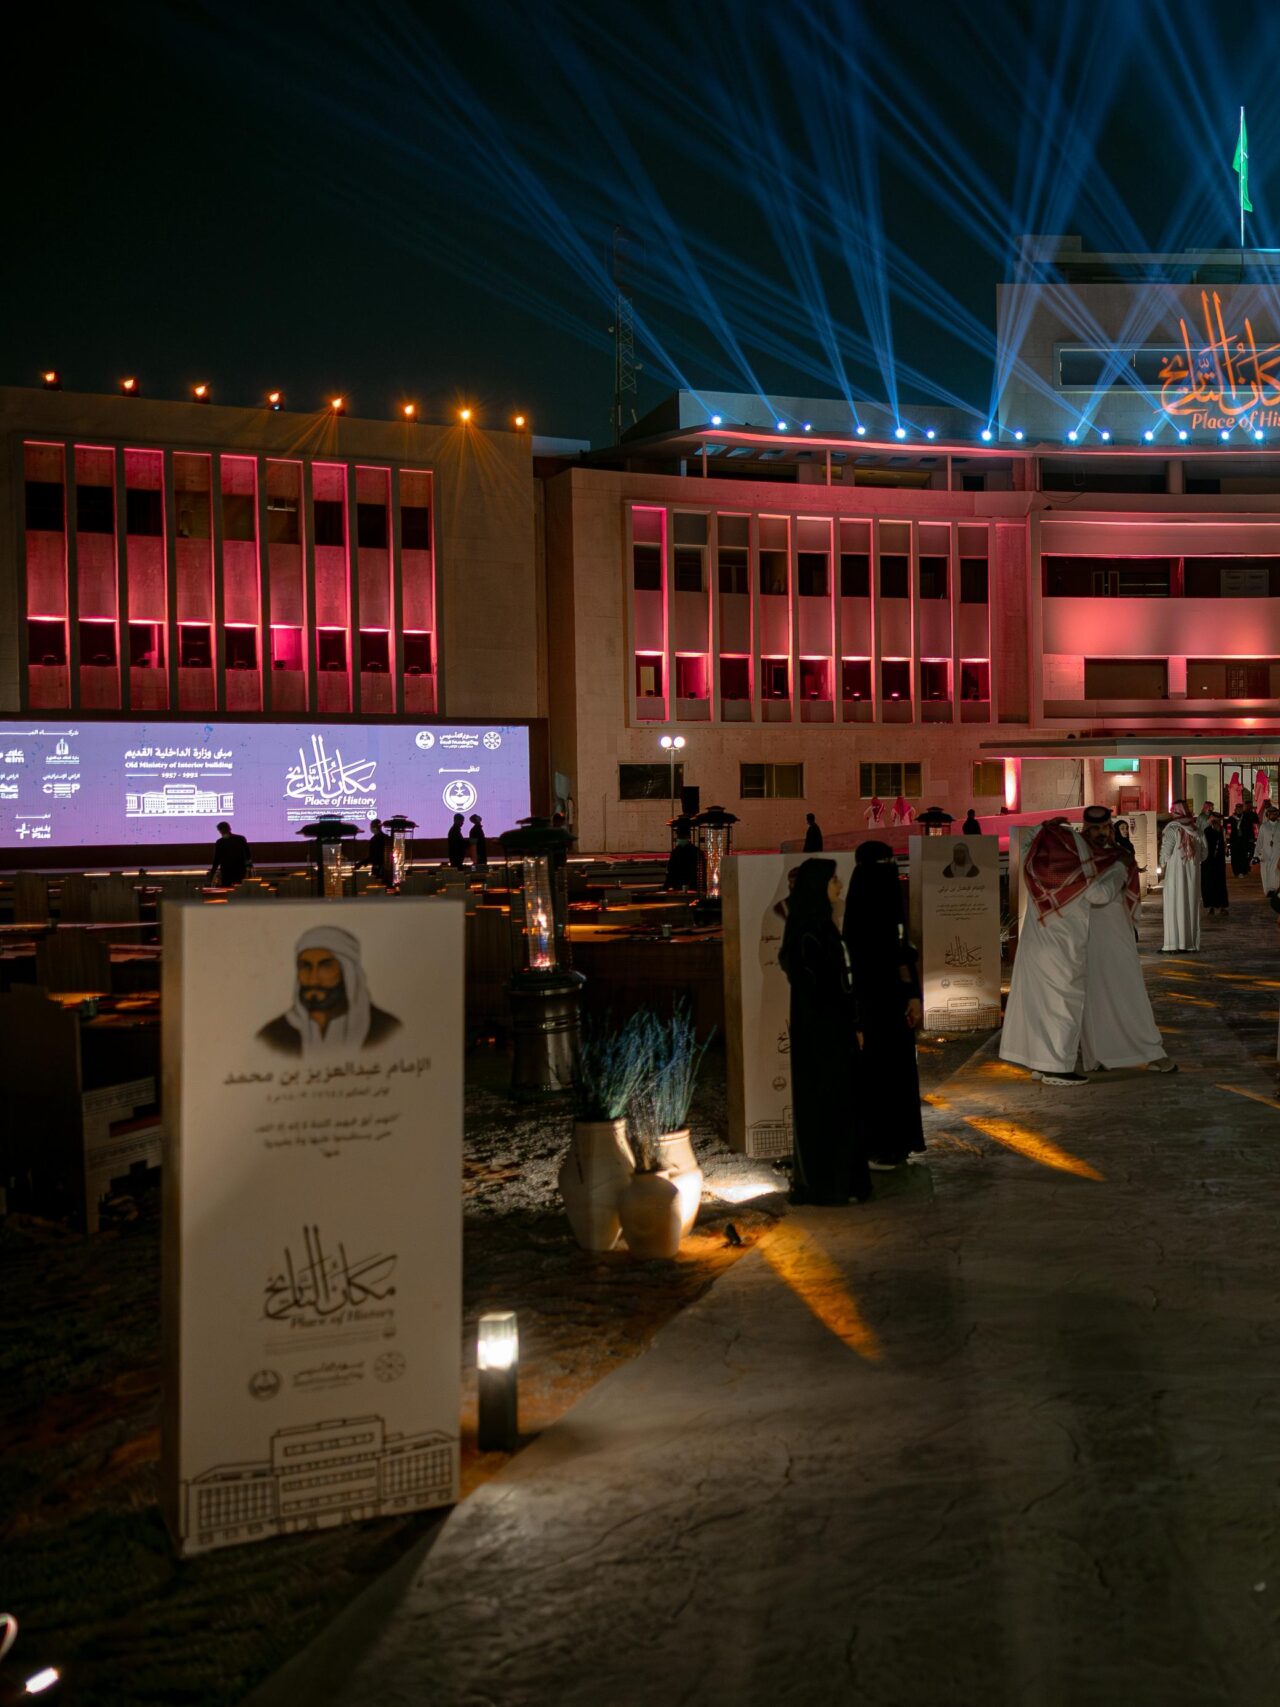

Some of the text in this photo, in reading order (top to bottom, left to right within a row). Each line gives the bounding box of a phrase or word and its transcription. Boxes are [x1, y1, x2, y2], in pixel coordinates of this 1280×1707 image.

[1192, 413, 1236, 430] Place
[1239, 411, 1258, 432] of
[4, 756, 24, 764] elm
[124, 747, 233, 760] مبنى وزارة الداخلية القديم
[140, 762, 167, 770] Ministry
[204, 762, 233, 770] building
[320, 748, 377, 799] مكان
[304, 795, 377, 808] Place of History
[386, 1056, 433, 1080] الإمام
[222, 1071, 275, 1086] محمد
[279, 1070, 300, 1087] بن
[313, 1242, 398, 1317] مكان
